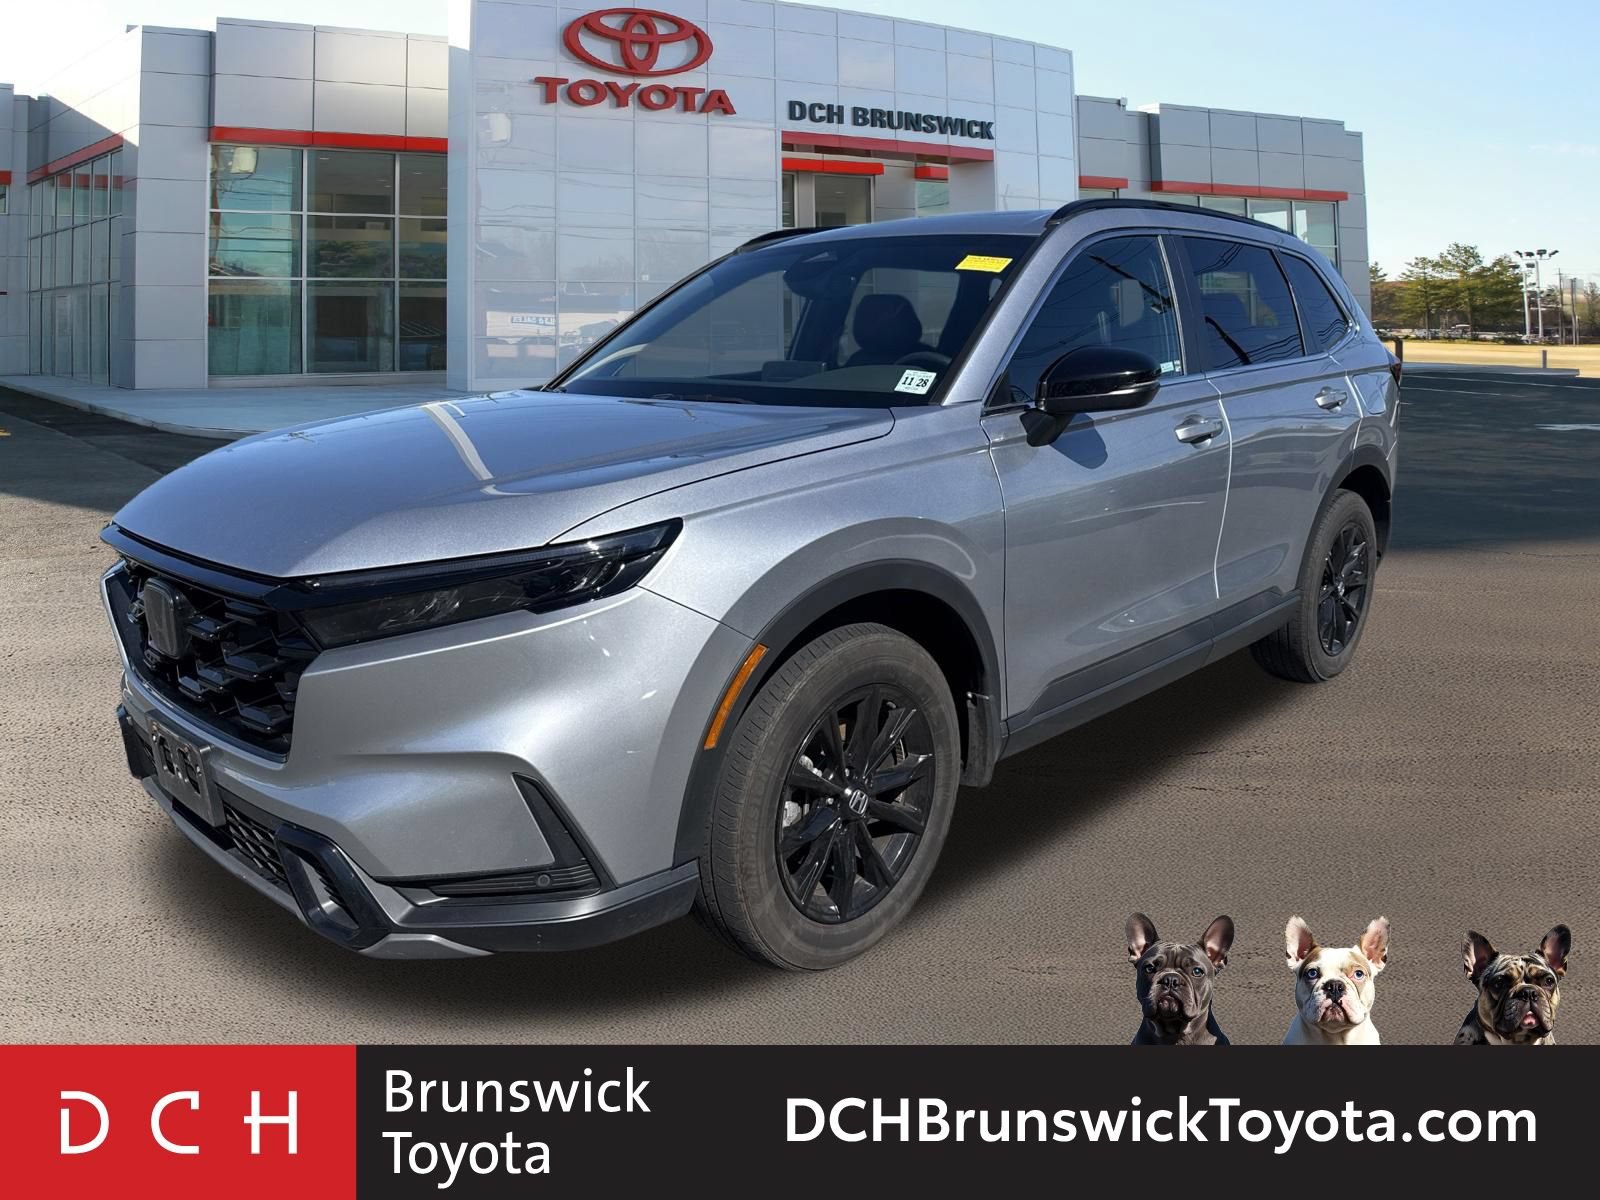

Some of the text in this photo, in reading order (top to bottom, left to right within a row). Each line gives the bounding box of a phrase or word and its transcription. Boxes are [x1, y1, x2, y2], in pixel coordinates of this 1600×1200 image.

[534, 76, 736, 115] TOYOTA
[788, 101, 995, 140] DCH BRUNSWICK
[901, 376, 929, 388] 11 28
